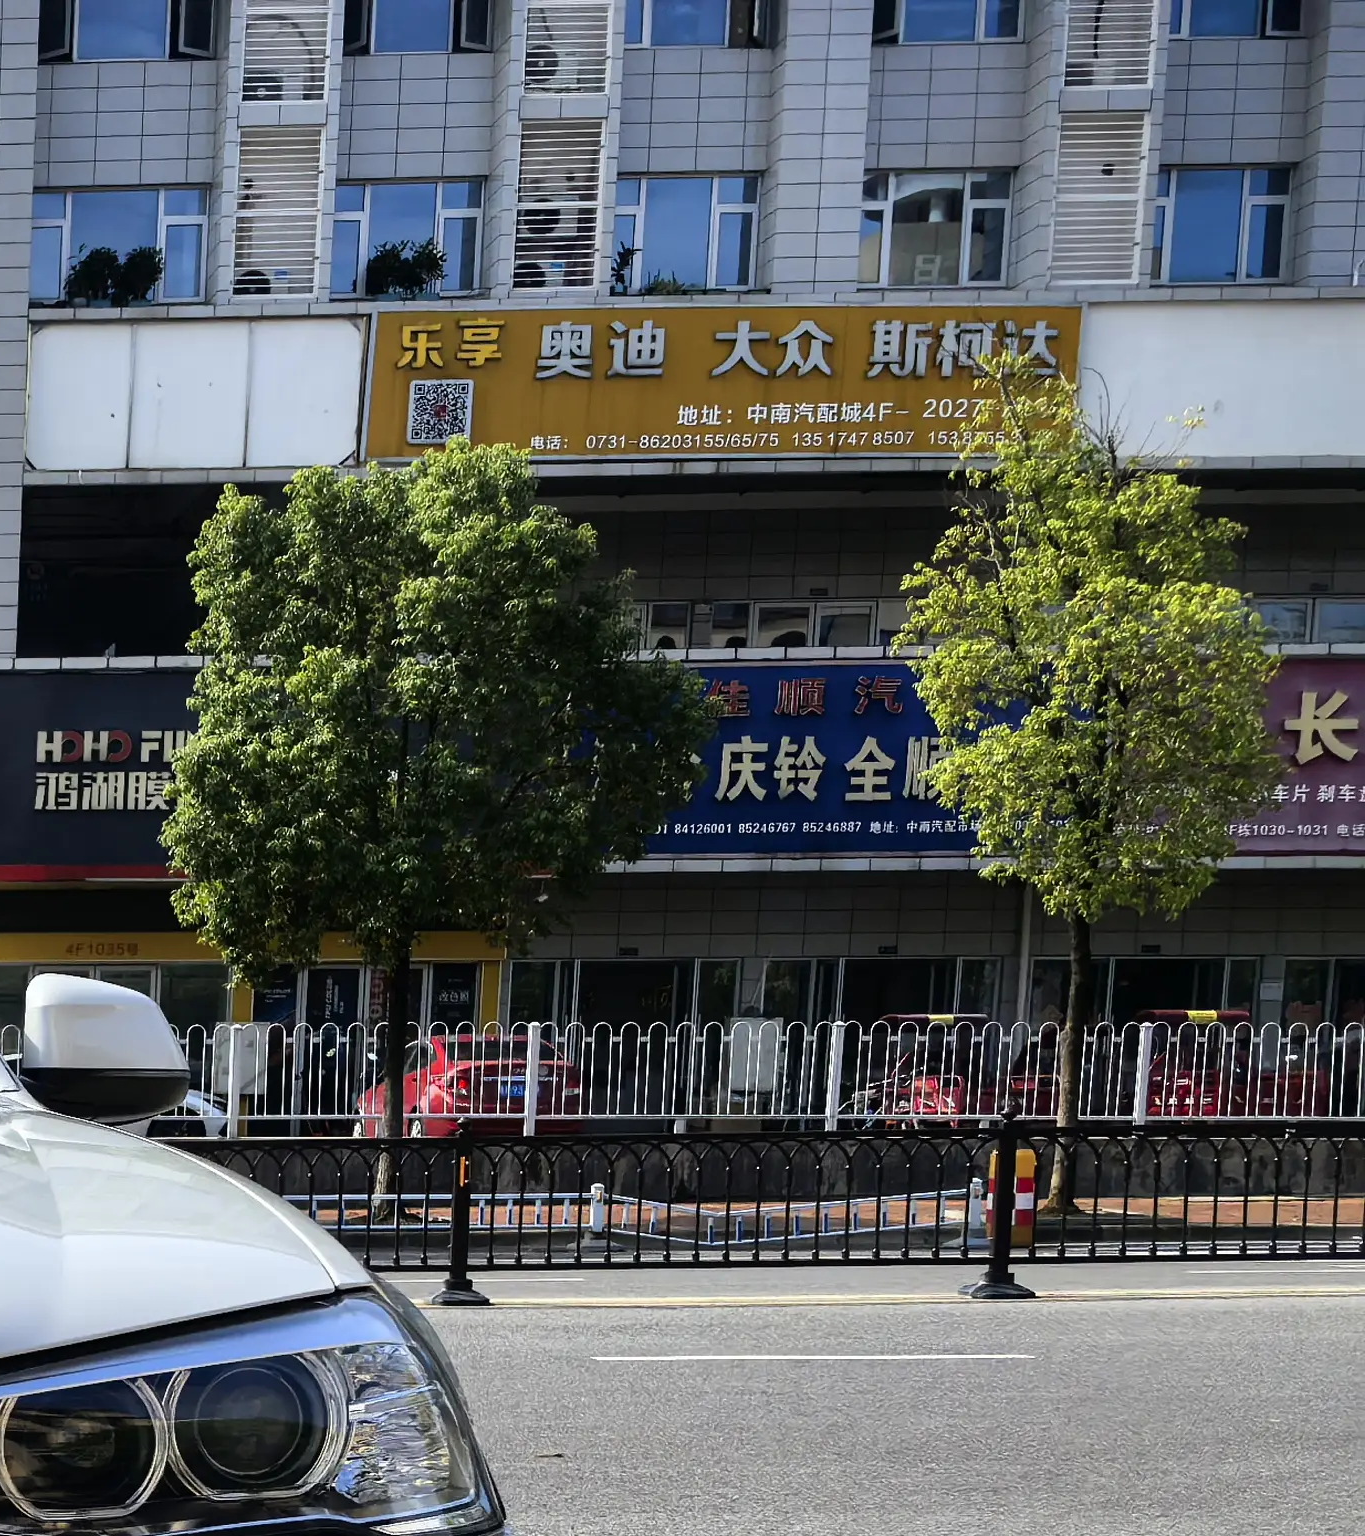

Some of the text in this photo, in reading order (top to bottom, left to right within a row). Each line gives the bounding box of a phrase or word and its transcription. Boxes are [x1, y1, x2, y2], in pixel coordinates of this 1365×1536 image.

[397, 317, 1060, 380] 乐享 奥迪 大众 斯柯达
[585, 431, 780, 449] 0731-86203155/65/75
[35, 729, 193, 763] HOHO FI
[1283, 689, 1360, 766] 长
[714, 735, 827, 802] 庆铃
[34, 771, 182, 811] 鸿湖膜
[1258, 784, 1311, 803] 车片
[674, 822, 732, 835] 84126001
